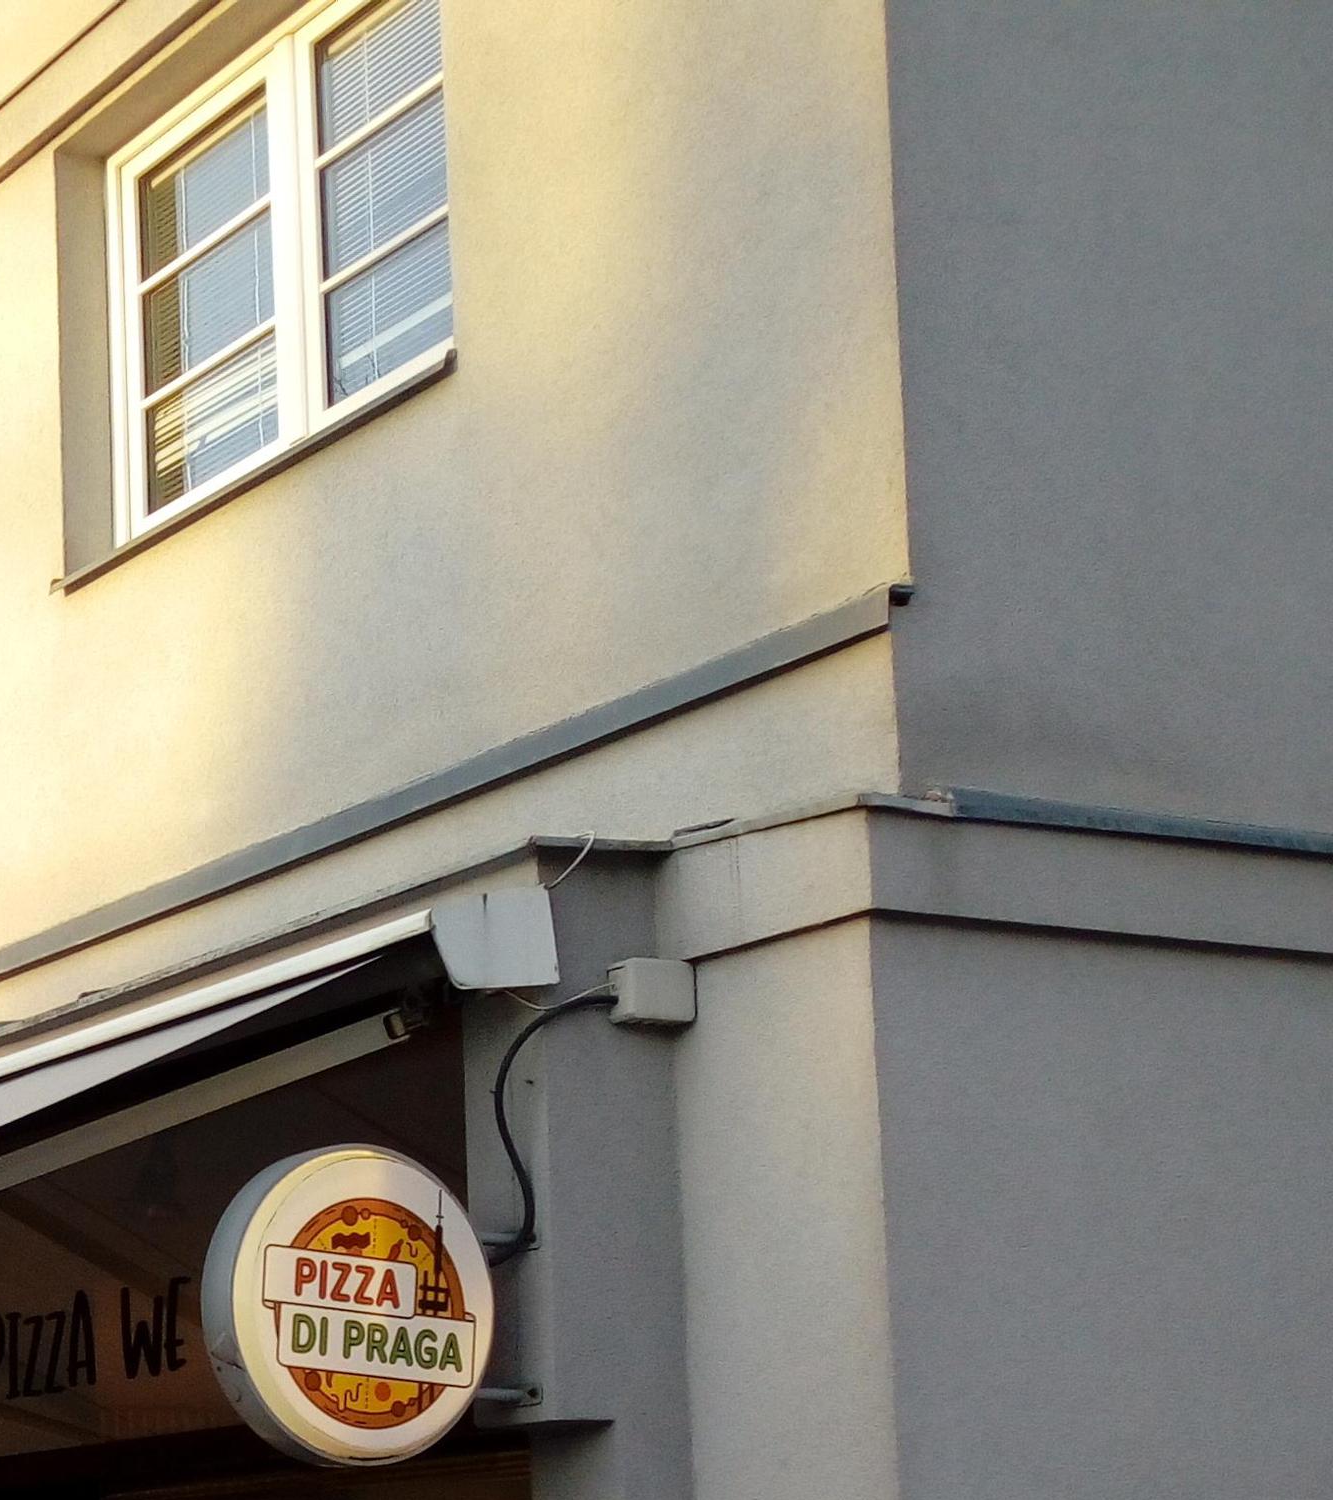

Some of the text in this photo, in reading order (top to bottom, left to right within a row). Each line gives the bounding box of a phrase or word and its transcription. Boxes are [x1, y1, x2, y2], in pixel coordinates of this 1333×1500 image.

[294, 1257, 400, 1309] PIZZA
[120, 1276, 191, 1380] WE
[291, 1314, 462, 1373] DI PRAGA
